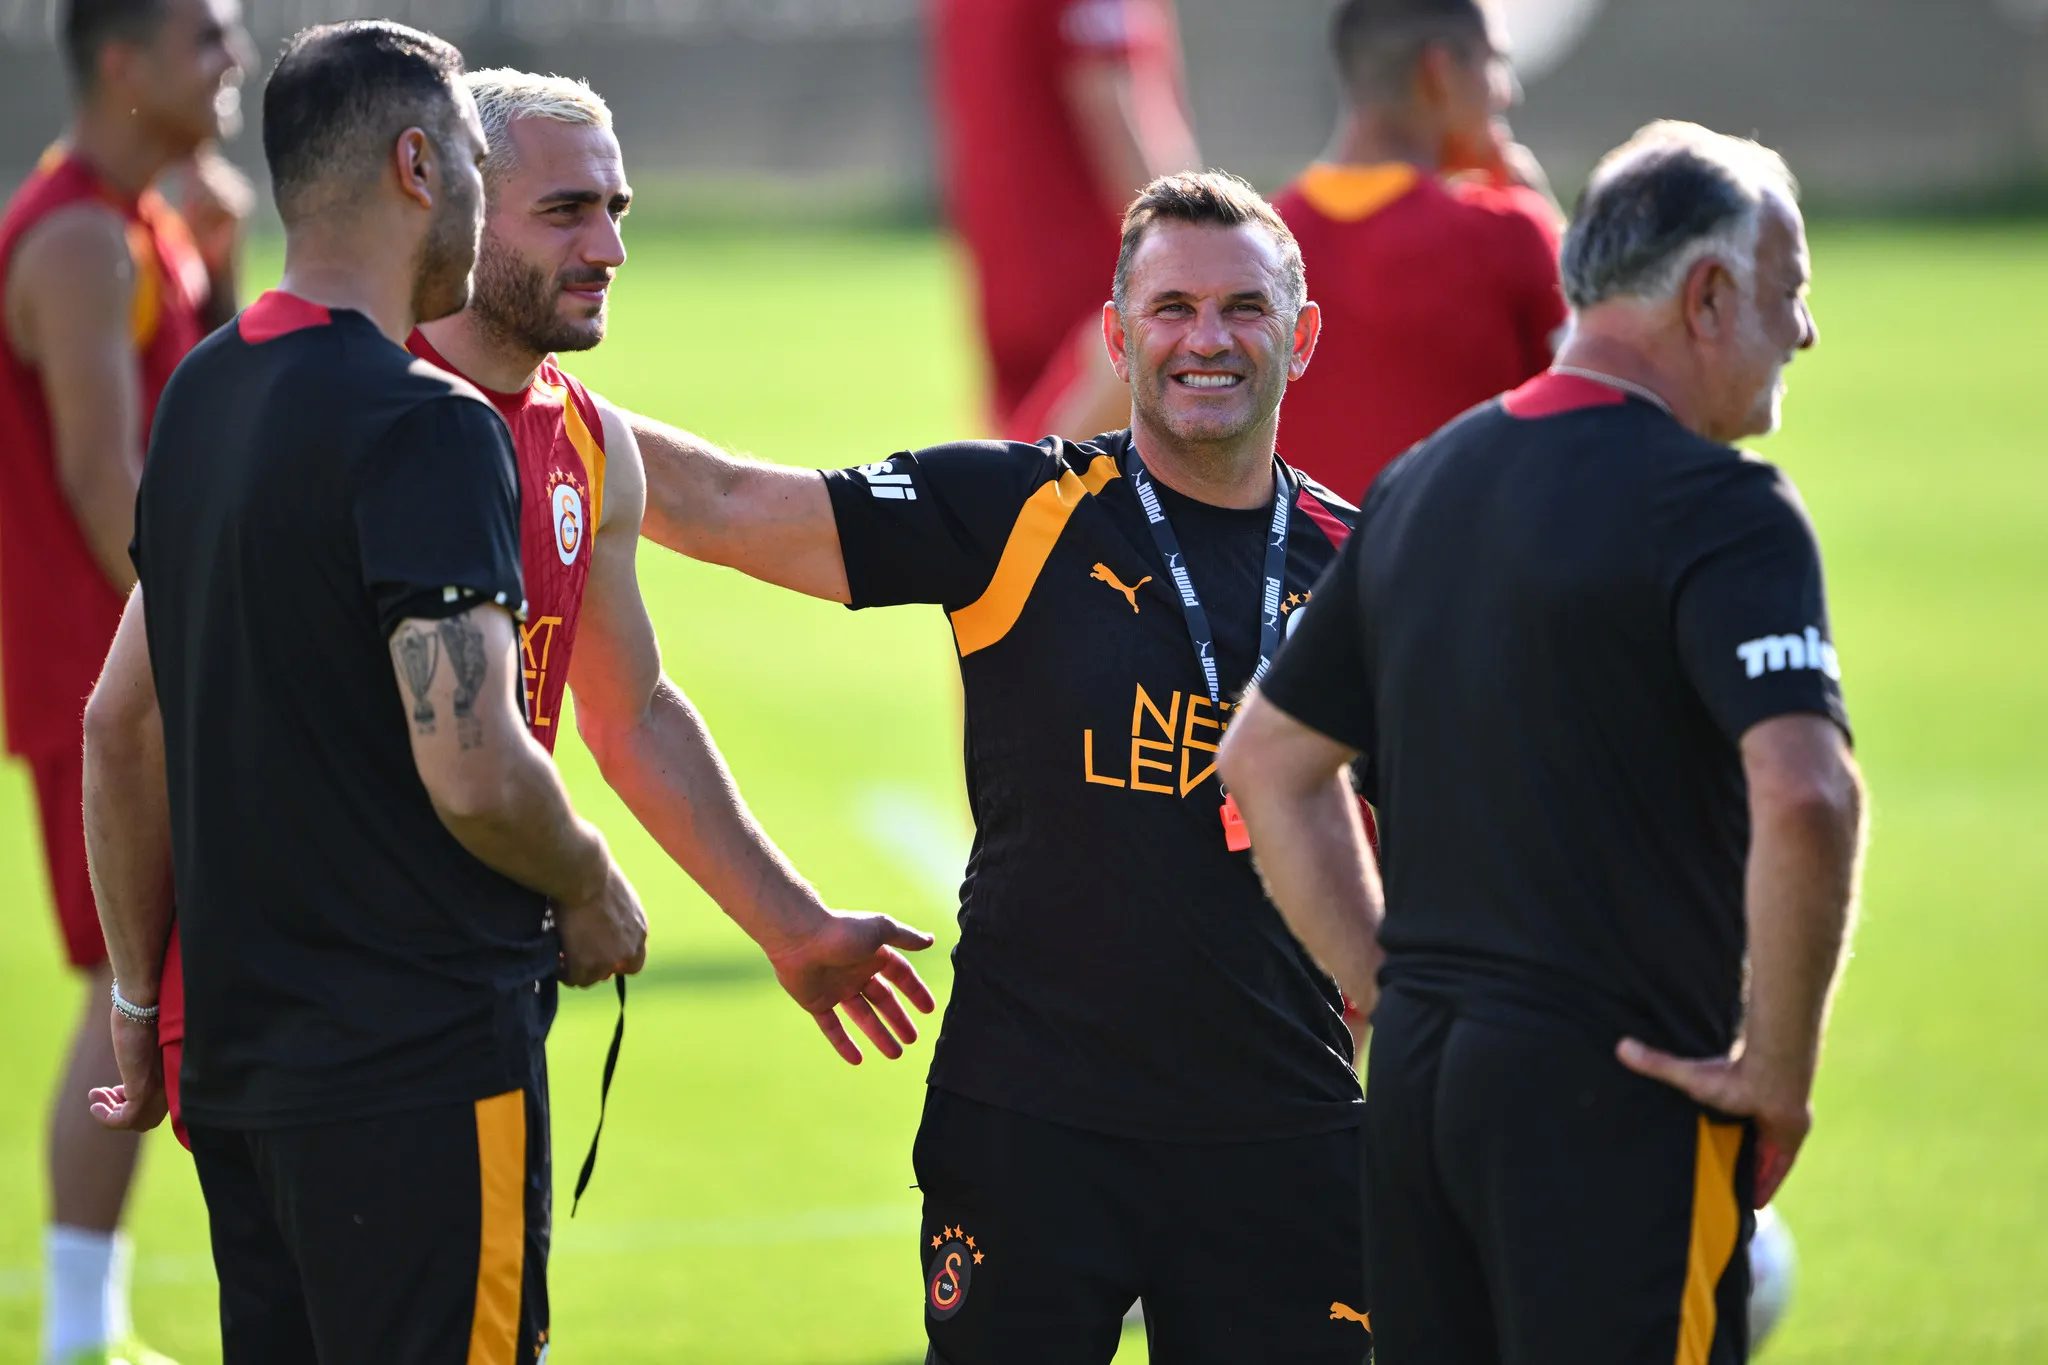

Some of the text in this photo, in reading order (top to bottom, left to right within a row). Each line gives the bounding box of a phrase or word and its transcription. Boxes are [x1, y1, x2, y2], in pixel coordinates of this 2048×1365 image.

[858, 460, 917, 500] sli
[1136, 481, 1165, 524] PUMA
[1271, 493, 1288, 536] PUMA
[1171, 566, 1199, 607] PUMA
[1264, 576, 1281, 617] PUMA
[1201, 656, 1220, 703] PUMA
[1131, 681, 1242, 753] NE
